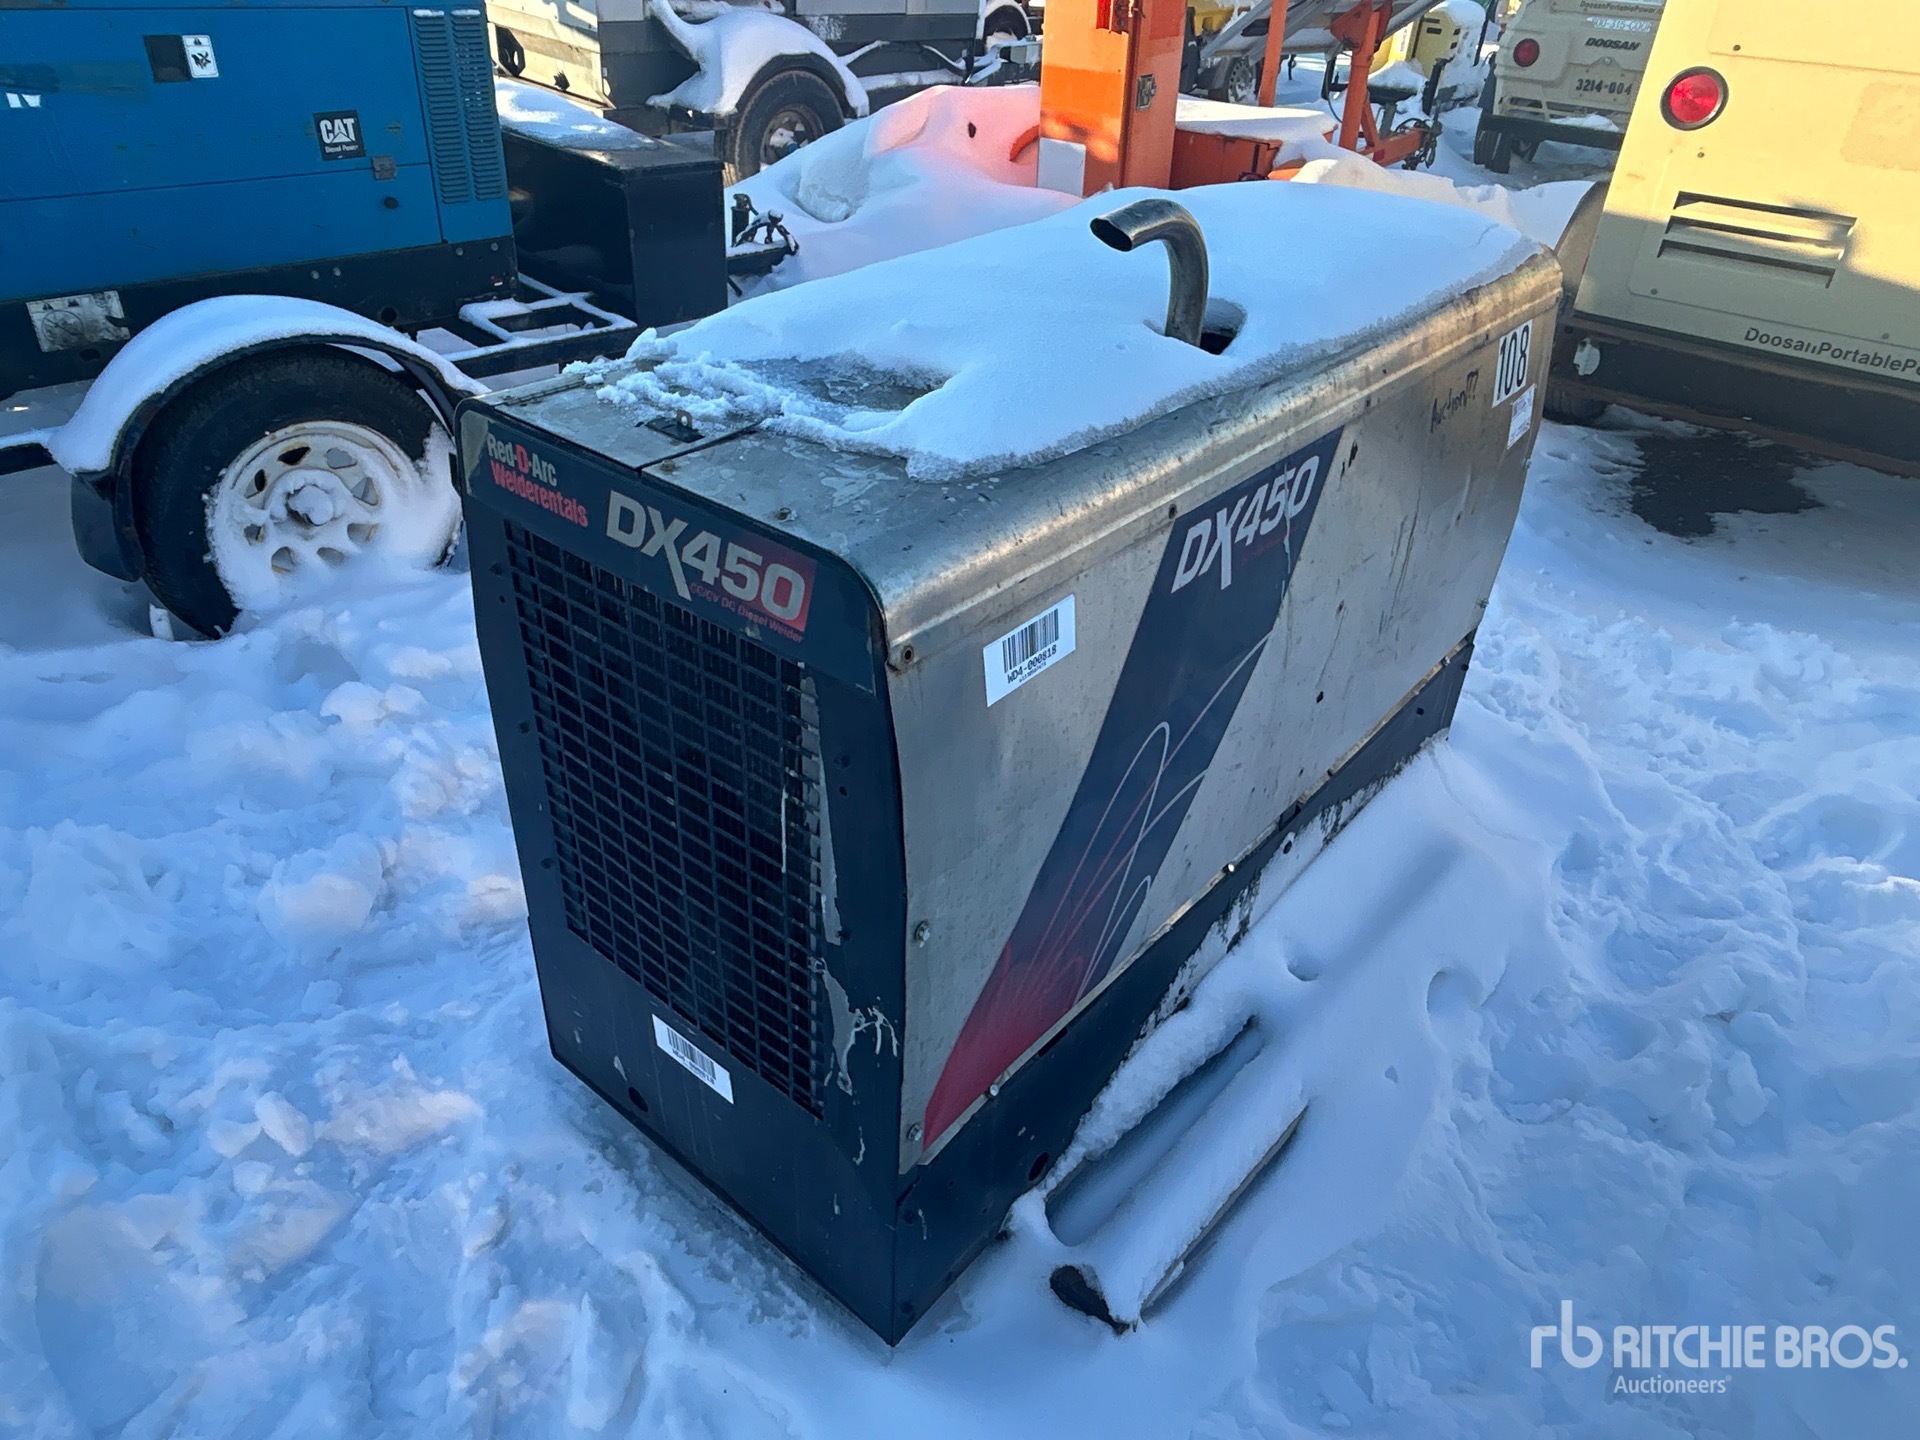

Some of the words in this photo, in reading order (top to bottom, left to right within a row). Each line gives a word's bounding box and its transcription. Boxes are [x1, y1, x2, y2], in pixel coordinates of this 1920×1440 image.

[1585, 37, 1640, 51] DOOSAN
[1576, 79, 1633, 95] 3214-004
[320, 118, 356, 144] CAT
[1497, 324, 1529, 401] 108
[487, 433, 557, 487] Red-D-Arc
[491, 459, 588, 528] Welderentals
[1171, 455, 1319, 593] DX450
[606, 491, 805, 621] DX450
[769, 619, 803, 642] Welder
